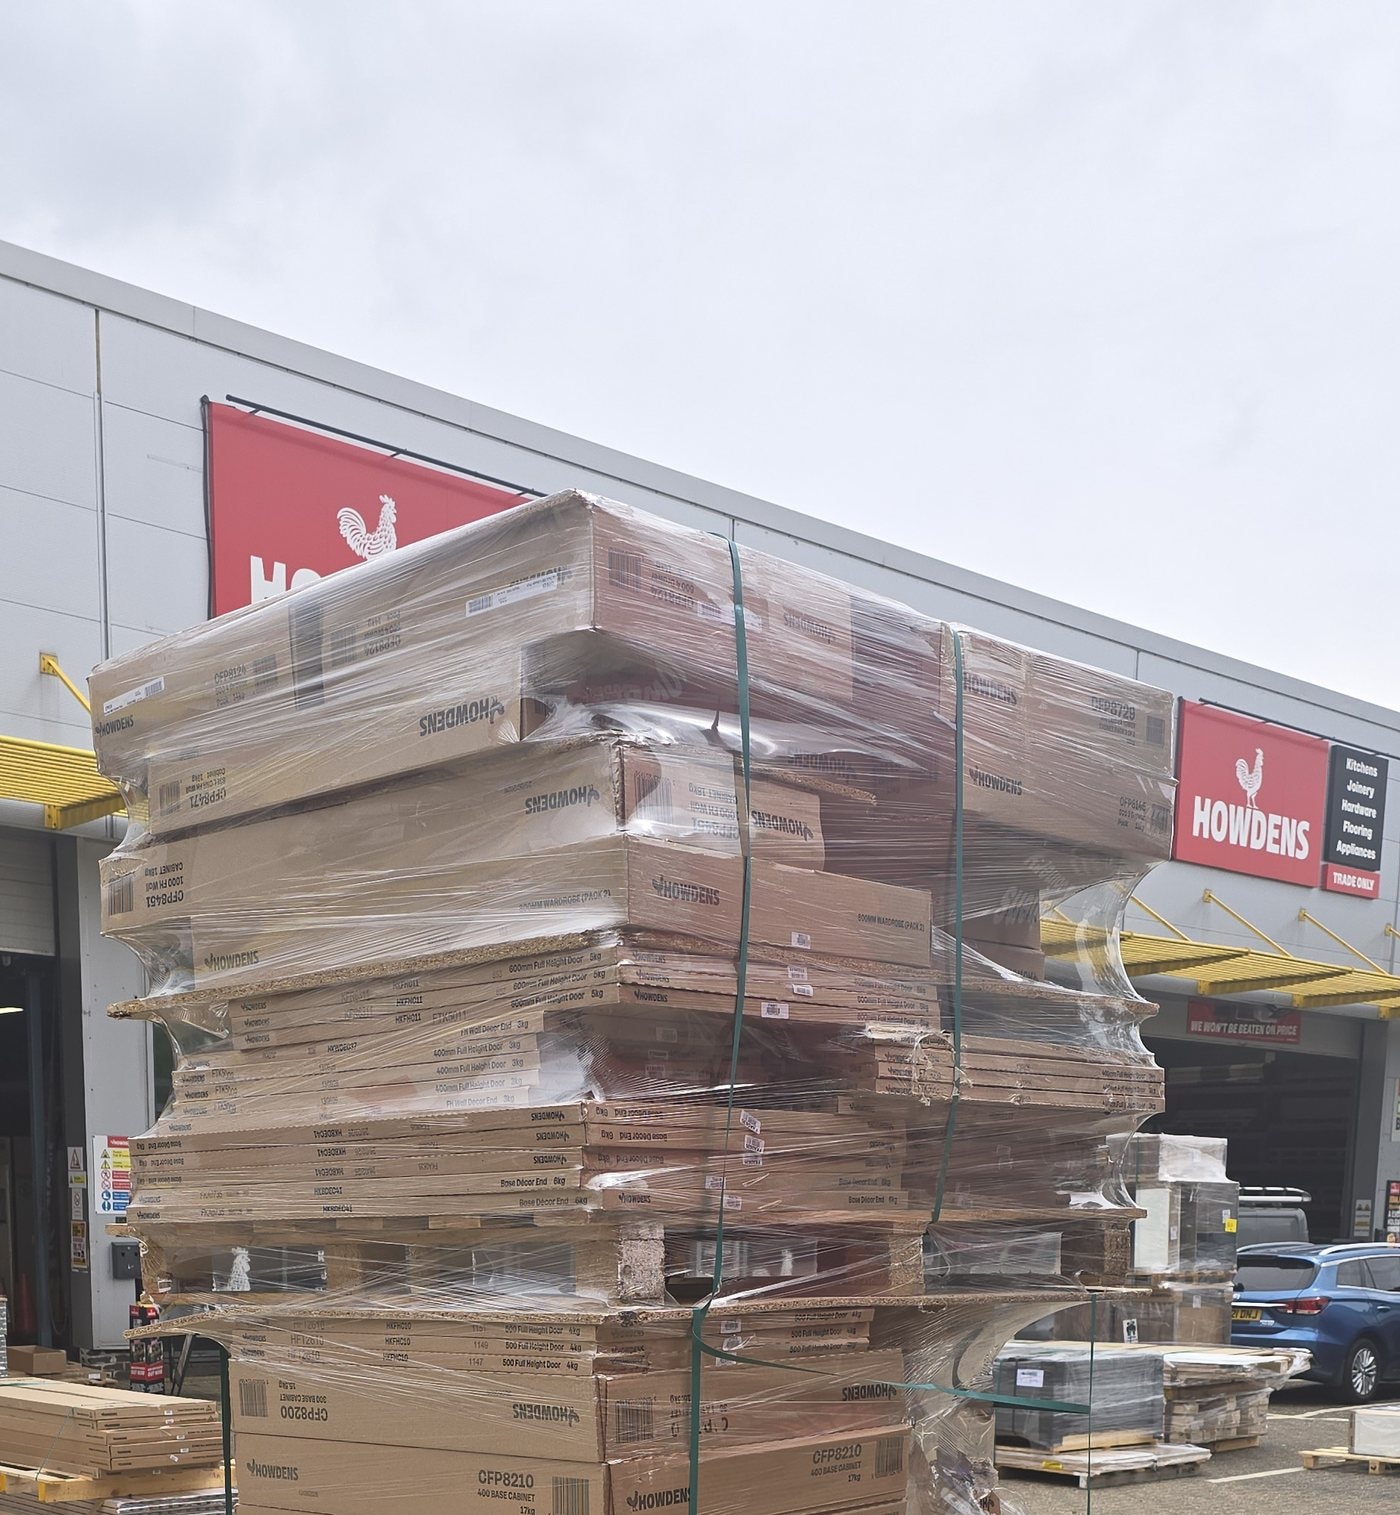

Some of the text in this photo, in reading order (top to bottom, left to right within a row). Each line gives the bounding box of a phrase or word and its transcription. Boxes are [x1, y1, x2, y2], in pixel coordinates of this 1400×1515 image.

[100, 714, 134, 738] HOWDENS
[420, 699, 496, 736] HOWDENS
[1345, 757, 1378, 778] Kitchens
[978, 773, 1022, 796] HOWDENS
[1347, 780, 1375, 799] Joinery
[190, 789, 226, 808] CFP8471
[525, 786, 586, 815] HOWDENS
[1341, 798, 1377, 819] Hardware
[751, 809, 803, 837] HOWDENS
[1192, 795, 1310, 860] HOWDENS
[1343, 820, 1373, 840] Flooring
[1336, 840, 1376, 860] Appliances
[159, 862, 184, 876] CABINET
[169, 876, 183, 888] 1000
[1333, 872, 1375, 891] TRADE ONLY
[147, 891, 184, 908] CFP8451
[663, 882, 720, 906] HOWDENS
[212, 950, 259, 971] HOWDENS
[509, 953, 601, 973] 600mm Full Height Door 5kg
[640, 991, 667, 1002] HOWDENS
[1191, 1020, 1296, 1035] WE WON'T BE BEATEN ON PRICE
[457, 1046, 467, 1055] Full
[489, 1043, 503, 1051] Door
[509, 1041, 520, 1050] 3kg
[437, 1059, 524, 1075] 400mm Full Height Door 3kg
[500, 1177, 565, 1187] Base Décor End 6kg
[520, 1198, 535, 1207] Base
[556, 1197, 568, 1205] End
[505, 1342, 517, 1350] 500
[518, 1342, 529, 1350] Full
[530, 1343, 549, 1352] Height
[550, 1343, 564, 1351] Door
[570, 1343, 581, 1352] 4kg
[469, 1358, 578, 1371] 1147 500 Full Height Door 4kg
[280, 1394, 326, 1404] 300 BASE CABINET
[842, 1383, 888, 1401] HOWDENS
[281, 1406, 328, 1421] CFP8200
[513, 1404, 568, 1422] HOWDENS
[812, 1444, 862, 1464] CFP8210
[255, 1466, 299, 1481] HOWDENS
[256, 1464, 298, 1480] HOWDENS
[811, 1461, 861, 1477] 400 BASE CABINET
[478, 1470, 534, 1489] CFP8210
[478, 1488, 535, 1503] 400 BASE CABINET
[638, 1487, 691, 1510] HOWDEN
[520, 1506, 535, 1515] 17kg
